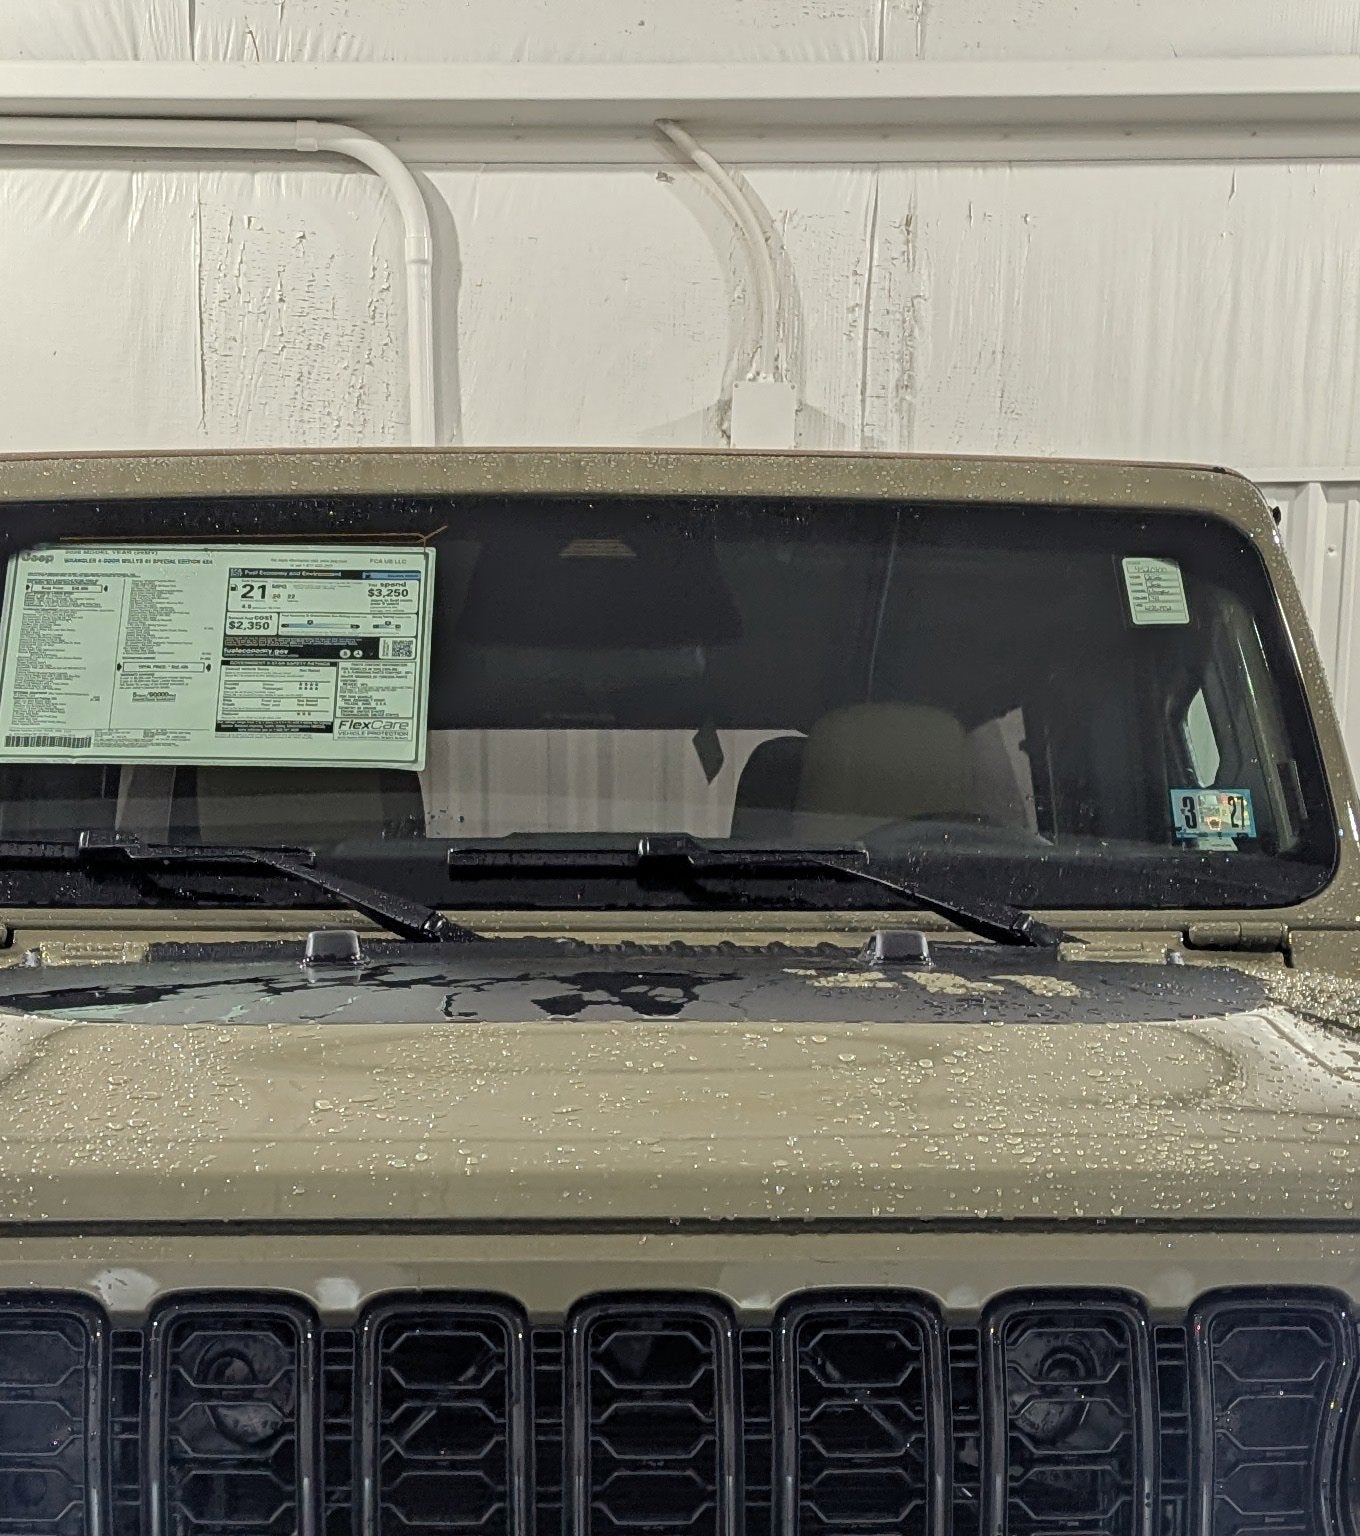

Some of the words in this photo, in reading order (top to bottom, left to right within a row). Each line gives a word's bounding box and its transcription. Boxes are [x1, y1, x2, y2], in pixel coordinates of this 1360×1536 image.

[240, 584, 267, 600] 21
[367, 588, 409, 598] $3,250
[228, 621, 270, 631] $2,350
[338, 719, 409, 730] FlexCare
[1182, 796, 1197, 829] 3
[1227, 796, 1246, 829] 27
